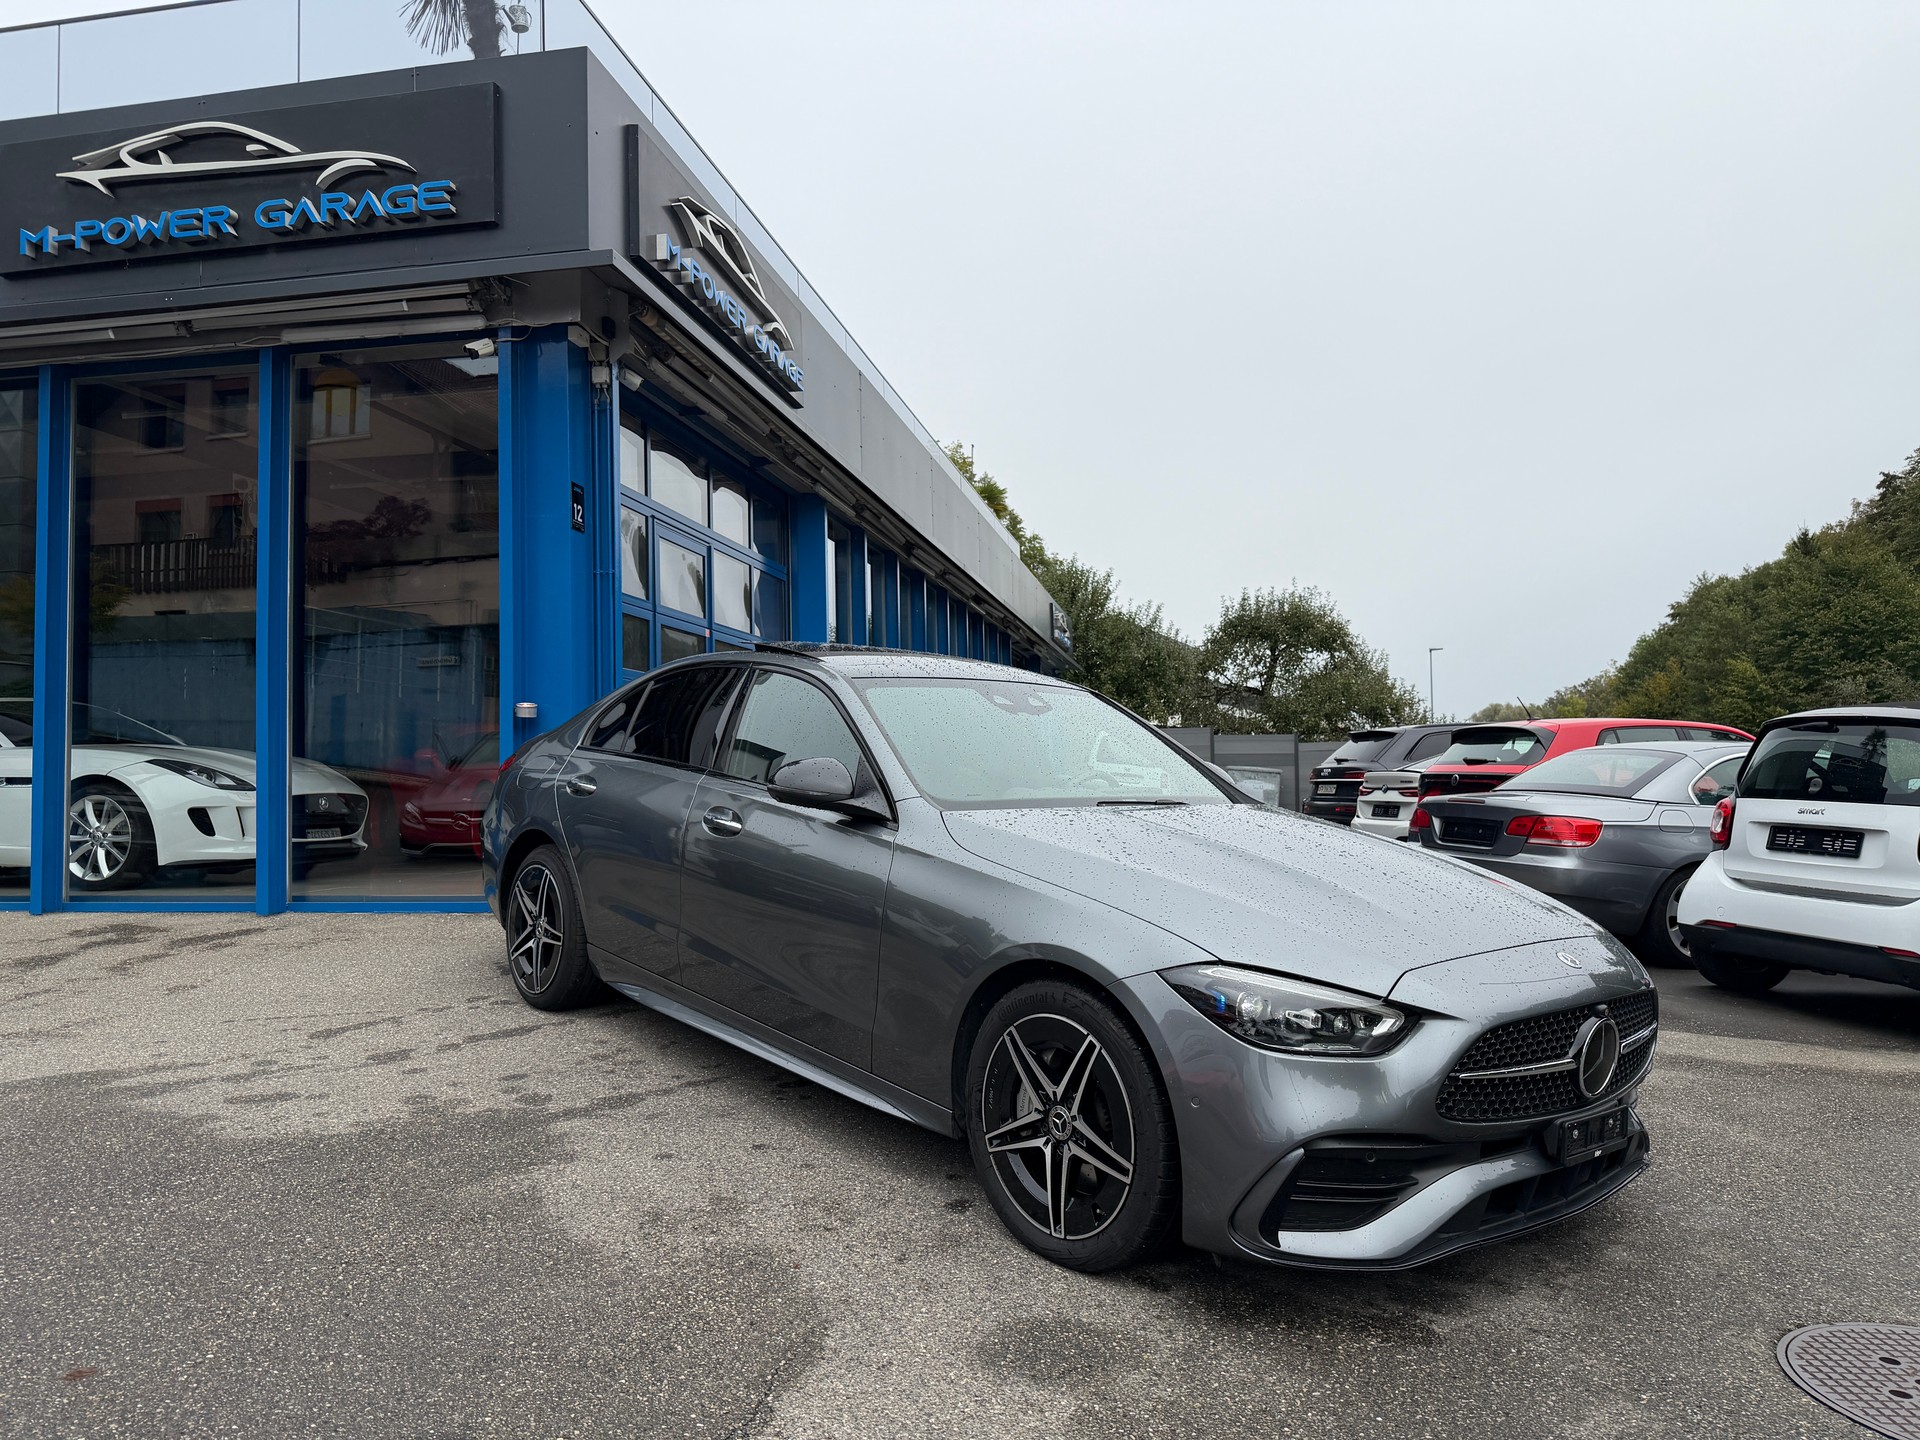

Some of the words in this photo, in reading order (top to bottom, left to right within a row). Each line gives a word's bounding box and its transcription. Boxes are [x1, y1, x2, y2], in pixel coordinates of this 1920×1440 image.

[19, 205, 236, 257] M-POWER
[254, 179, 456, 230] GARAGE
[664, 235, 748, 335] M-POWER
[752, 324, 805, 391] GARAGE
[574, 503, 583, 522] 12
[1797, 807, 1825, 815] smart
[998, 991, 1048, 1019] Continental
